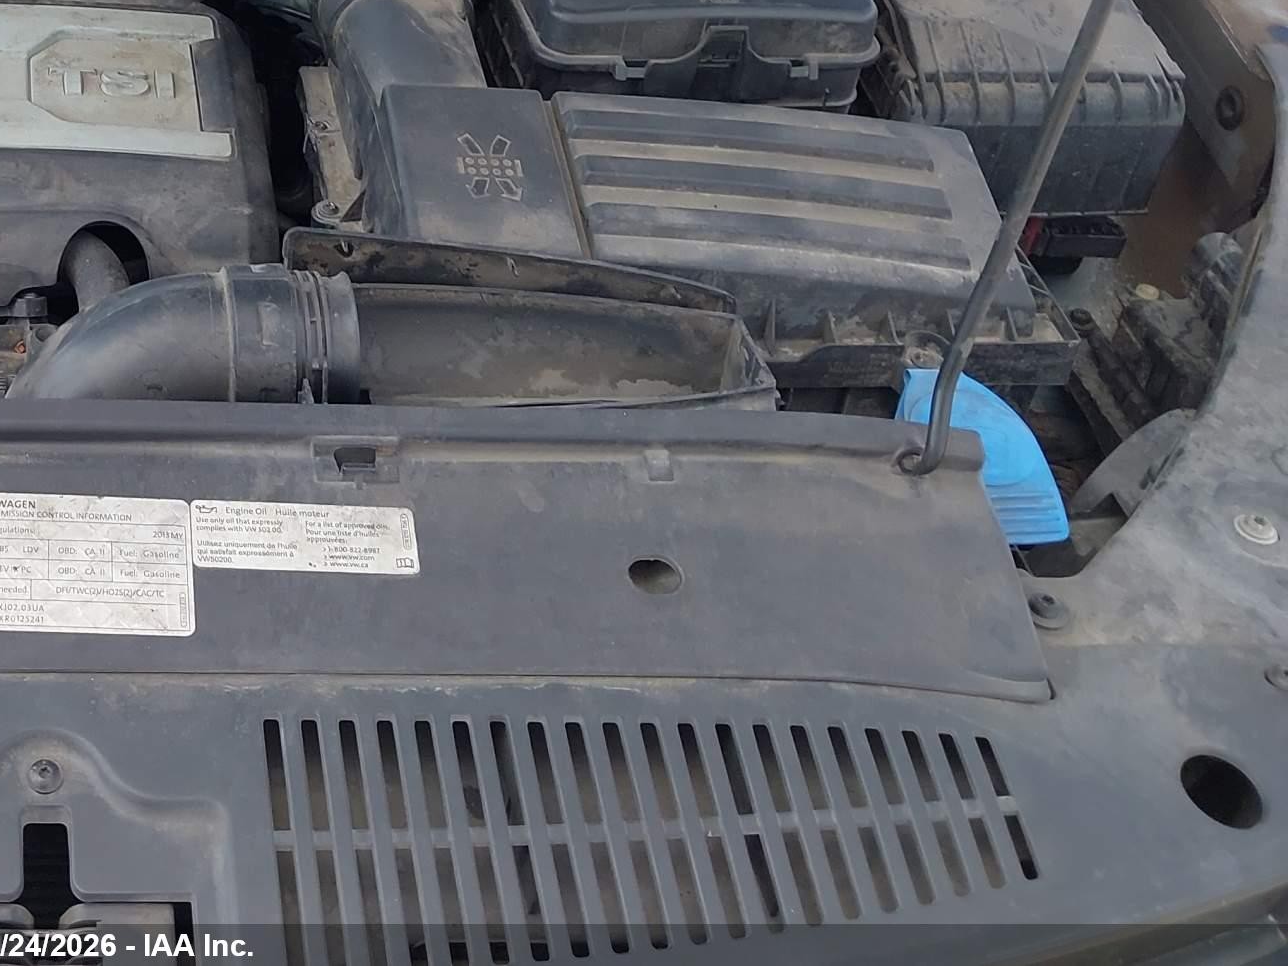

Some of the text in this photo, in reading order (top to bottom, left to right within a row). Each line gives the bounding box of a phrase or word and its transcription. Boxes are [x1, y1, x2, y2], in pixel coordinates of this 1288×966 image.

[47, 66, 176, 99] TSI
[36, 510, 73, 520] CONTROL
[75, 512, 132, 522] INFORMATION
[225, 506, 330, 518] Engine Oil Huile moteur
[210, 517, 224, 525] only
[196, 524, 226, 533] complies
[22, 545, 39, 553] LDV
[223, 541, 265, 549] uniquement
[143, 550, 180, 559] Gasoline
[143, 570, 181, 579] Gasoline
